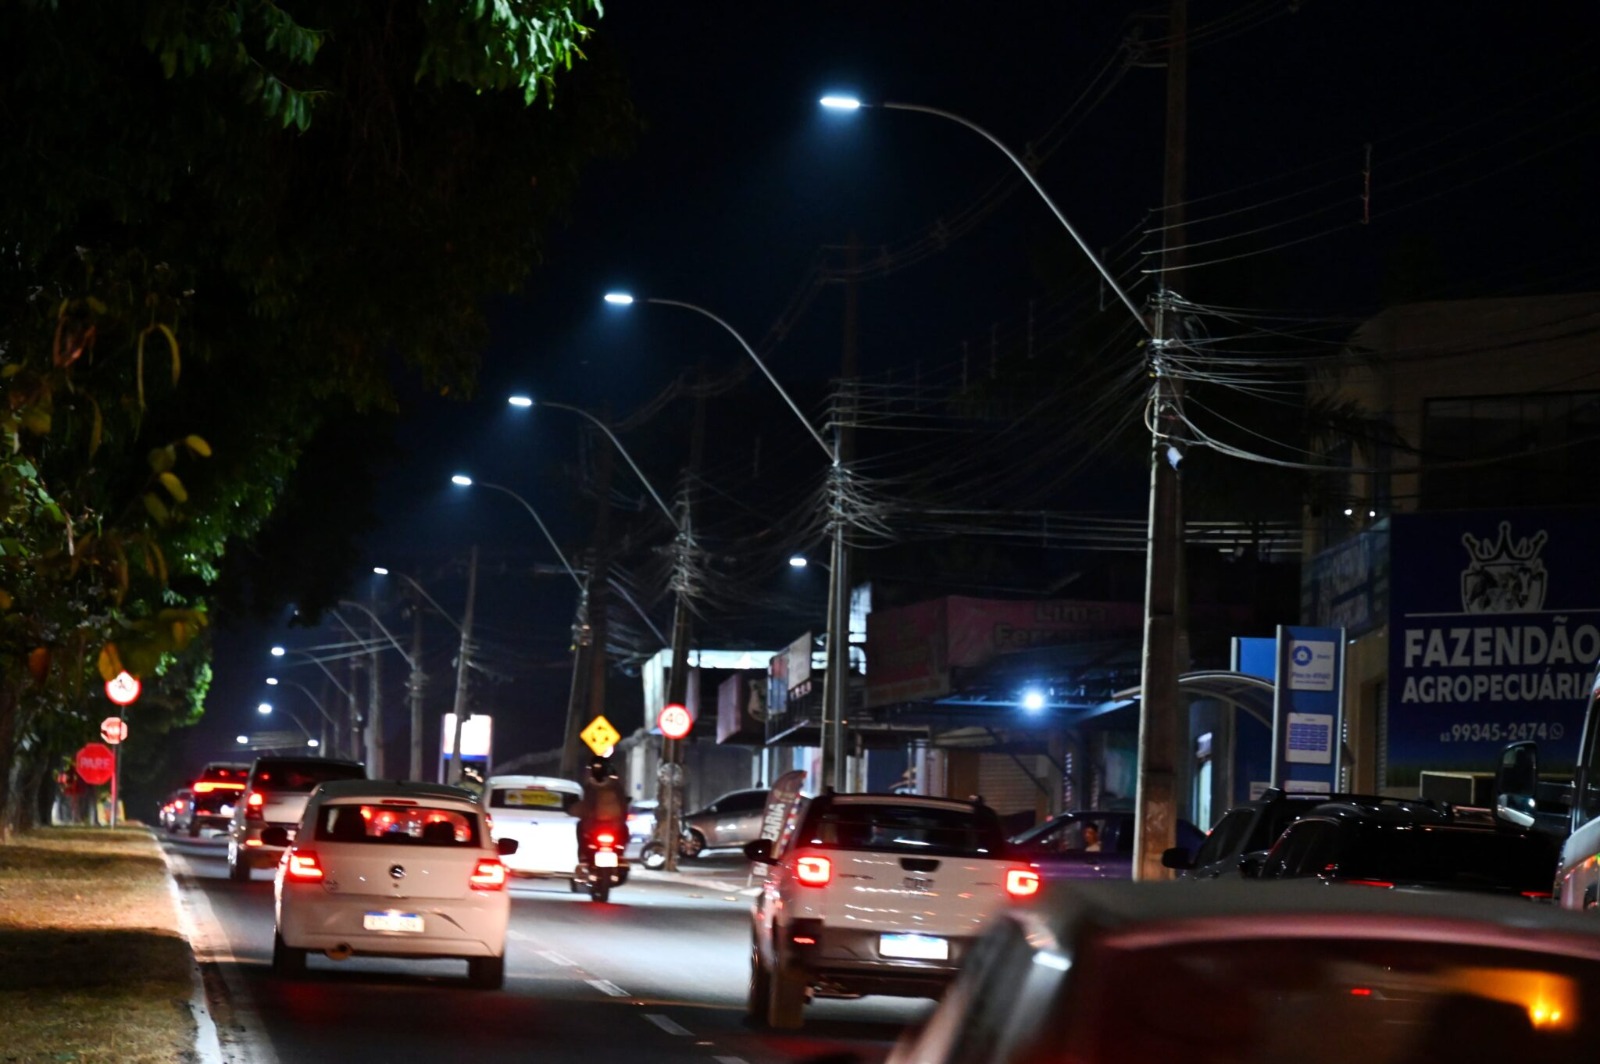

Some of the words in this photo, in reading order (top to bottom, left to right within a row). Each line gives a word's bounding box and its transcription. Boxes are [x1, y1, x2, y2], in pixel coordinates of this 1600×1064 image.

[1036, 601, 1106, 622] Lima
[1404, 616, 1600, 667] FAZENDÃO
[1452, 723, 1548, 742] 99345-2474
